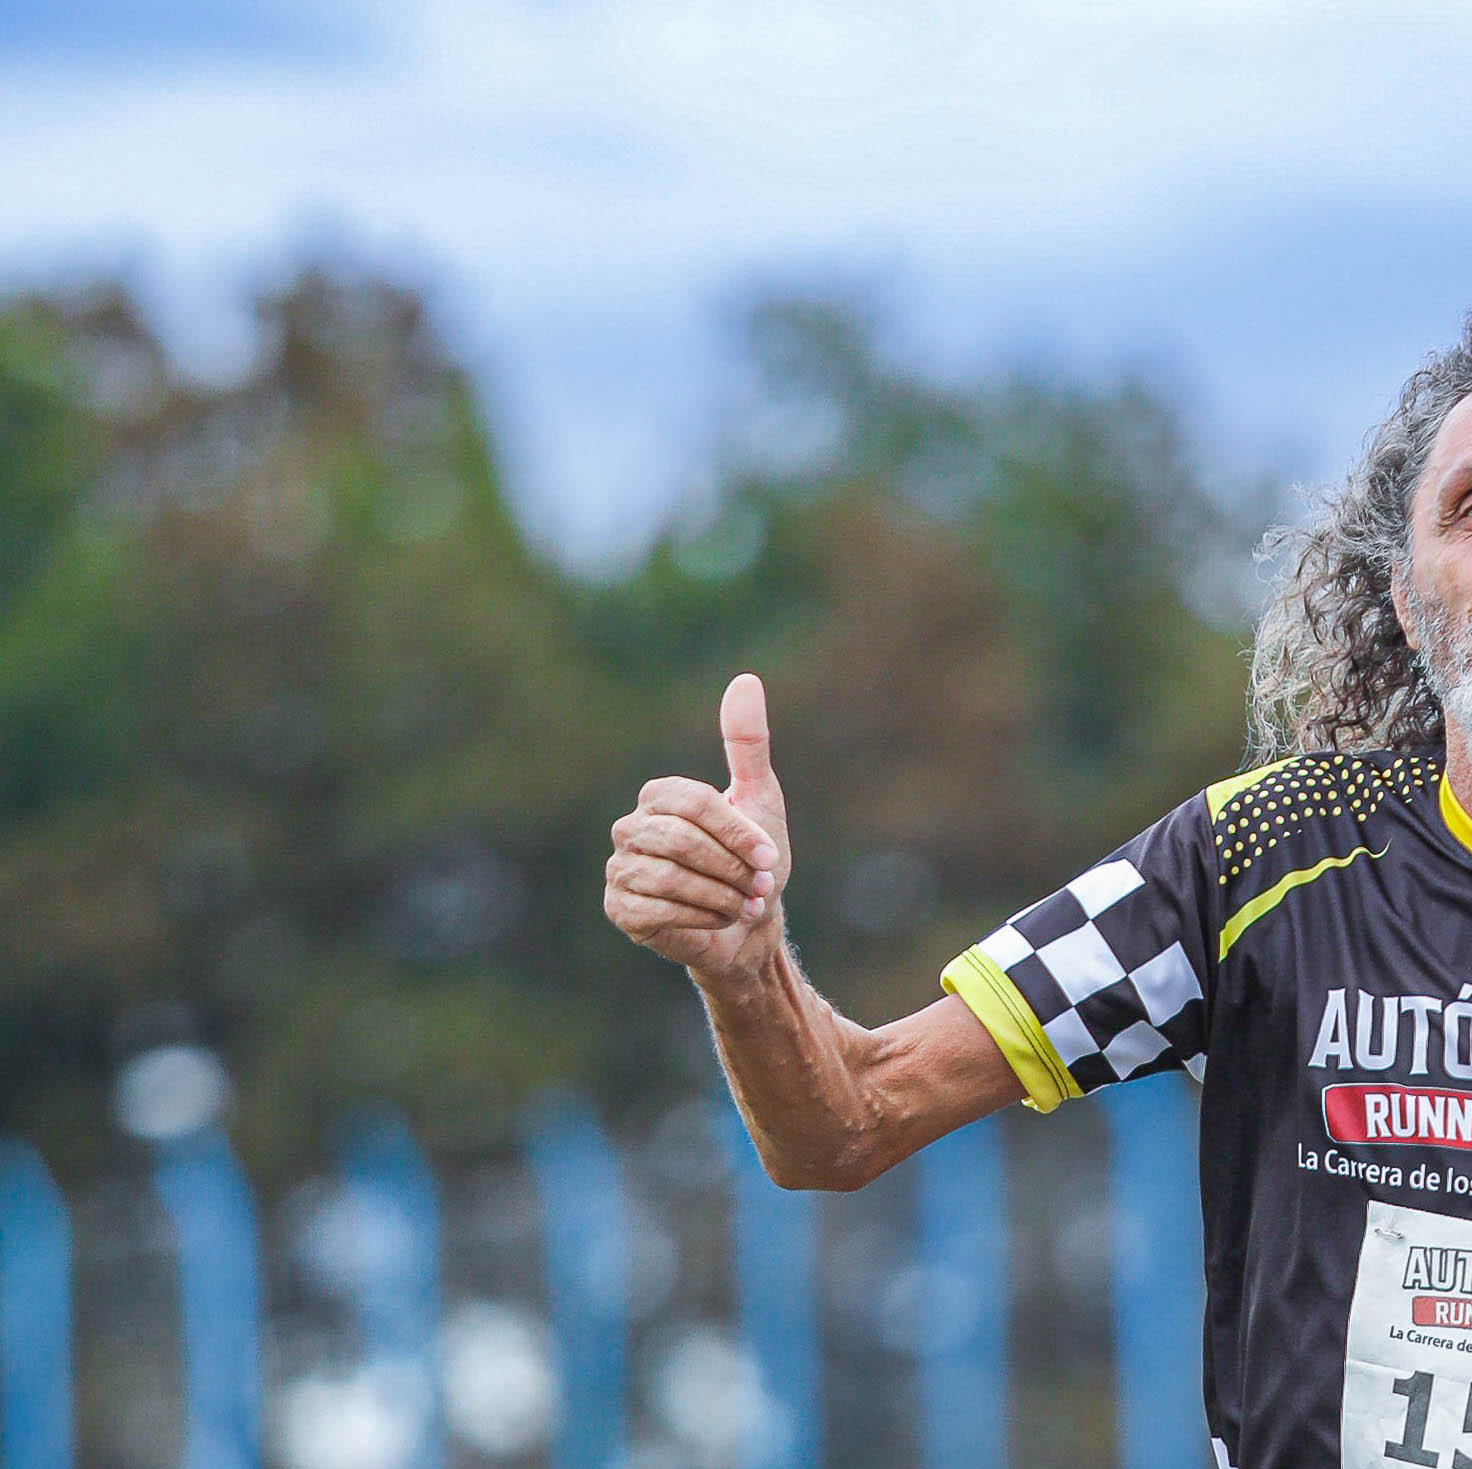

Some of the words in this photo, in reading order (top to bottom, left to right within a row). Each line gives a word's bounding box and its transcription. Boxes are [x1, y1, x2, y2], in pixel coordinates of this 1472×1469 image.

[1297, 1142, 1319, 1171] La
[1324, 1149, 1402, 1187] Carrera
[1409, 1163, 1441, 1192] de
[1389, 1325, 1403, 1340] La
[1406, 1329, 1453, 1350] Carrera
